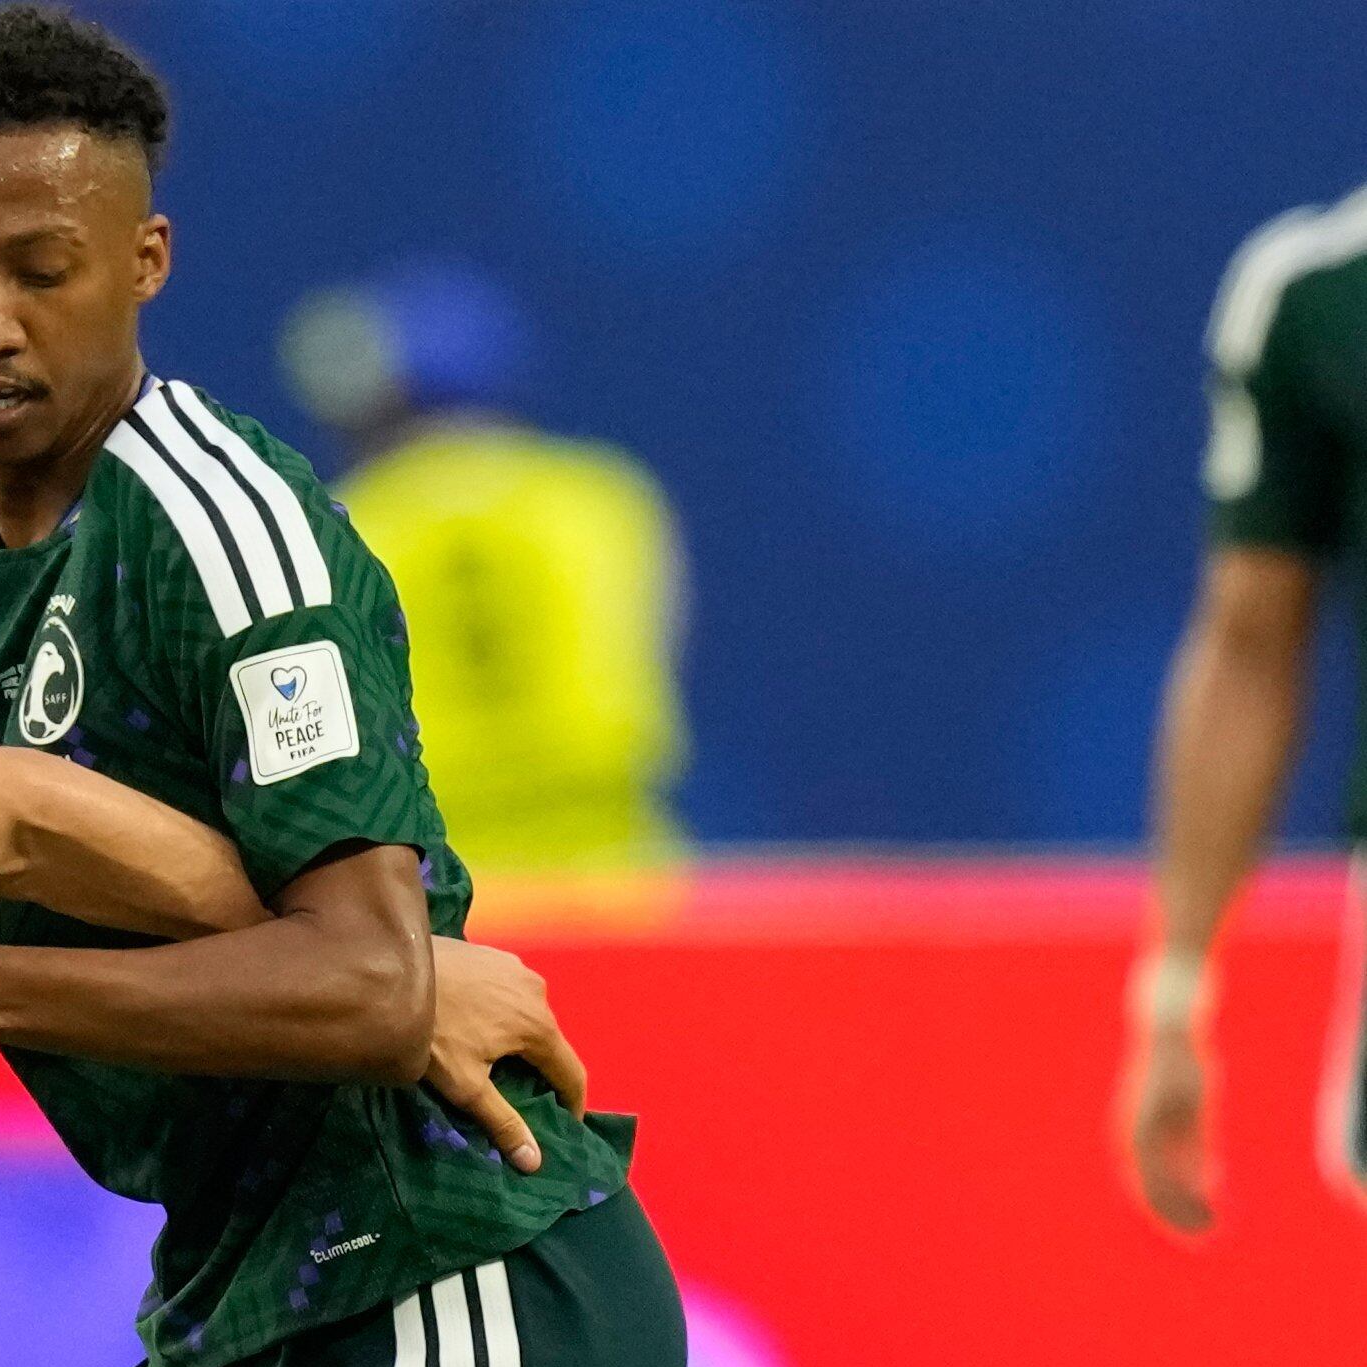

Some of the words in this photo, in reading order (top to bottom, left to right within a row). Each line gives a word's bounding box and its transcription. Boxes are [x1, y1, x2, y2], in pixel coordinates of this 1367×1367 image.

[267, 706, 302, 729] Unite
[302, 700, 323, 721] For
[275, 720, 325, 750] PEACE
[290, 746, 316, 760] FIFA
